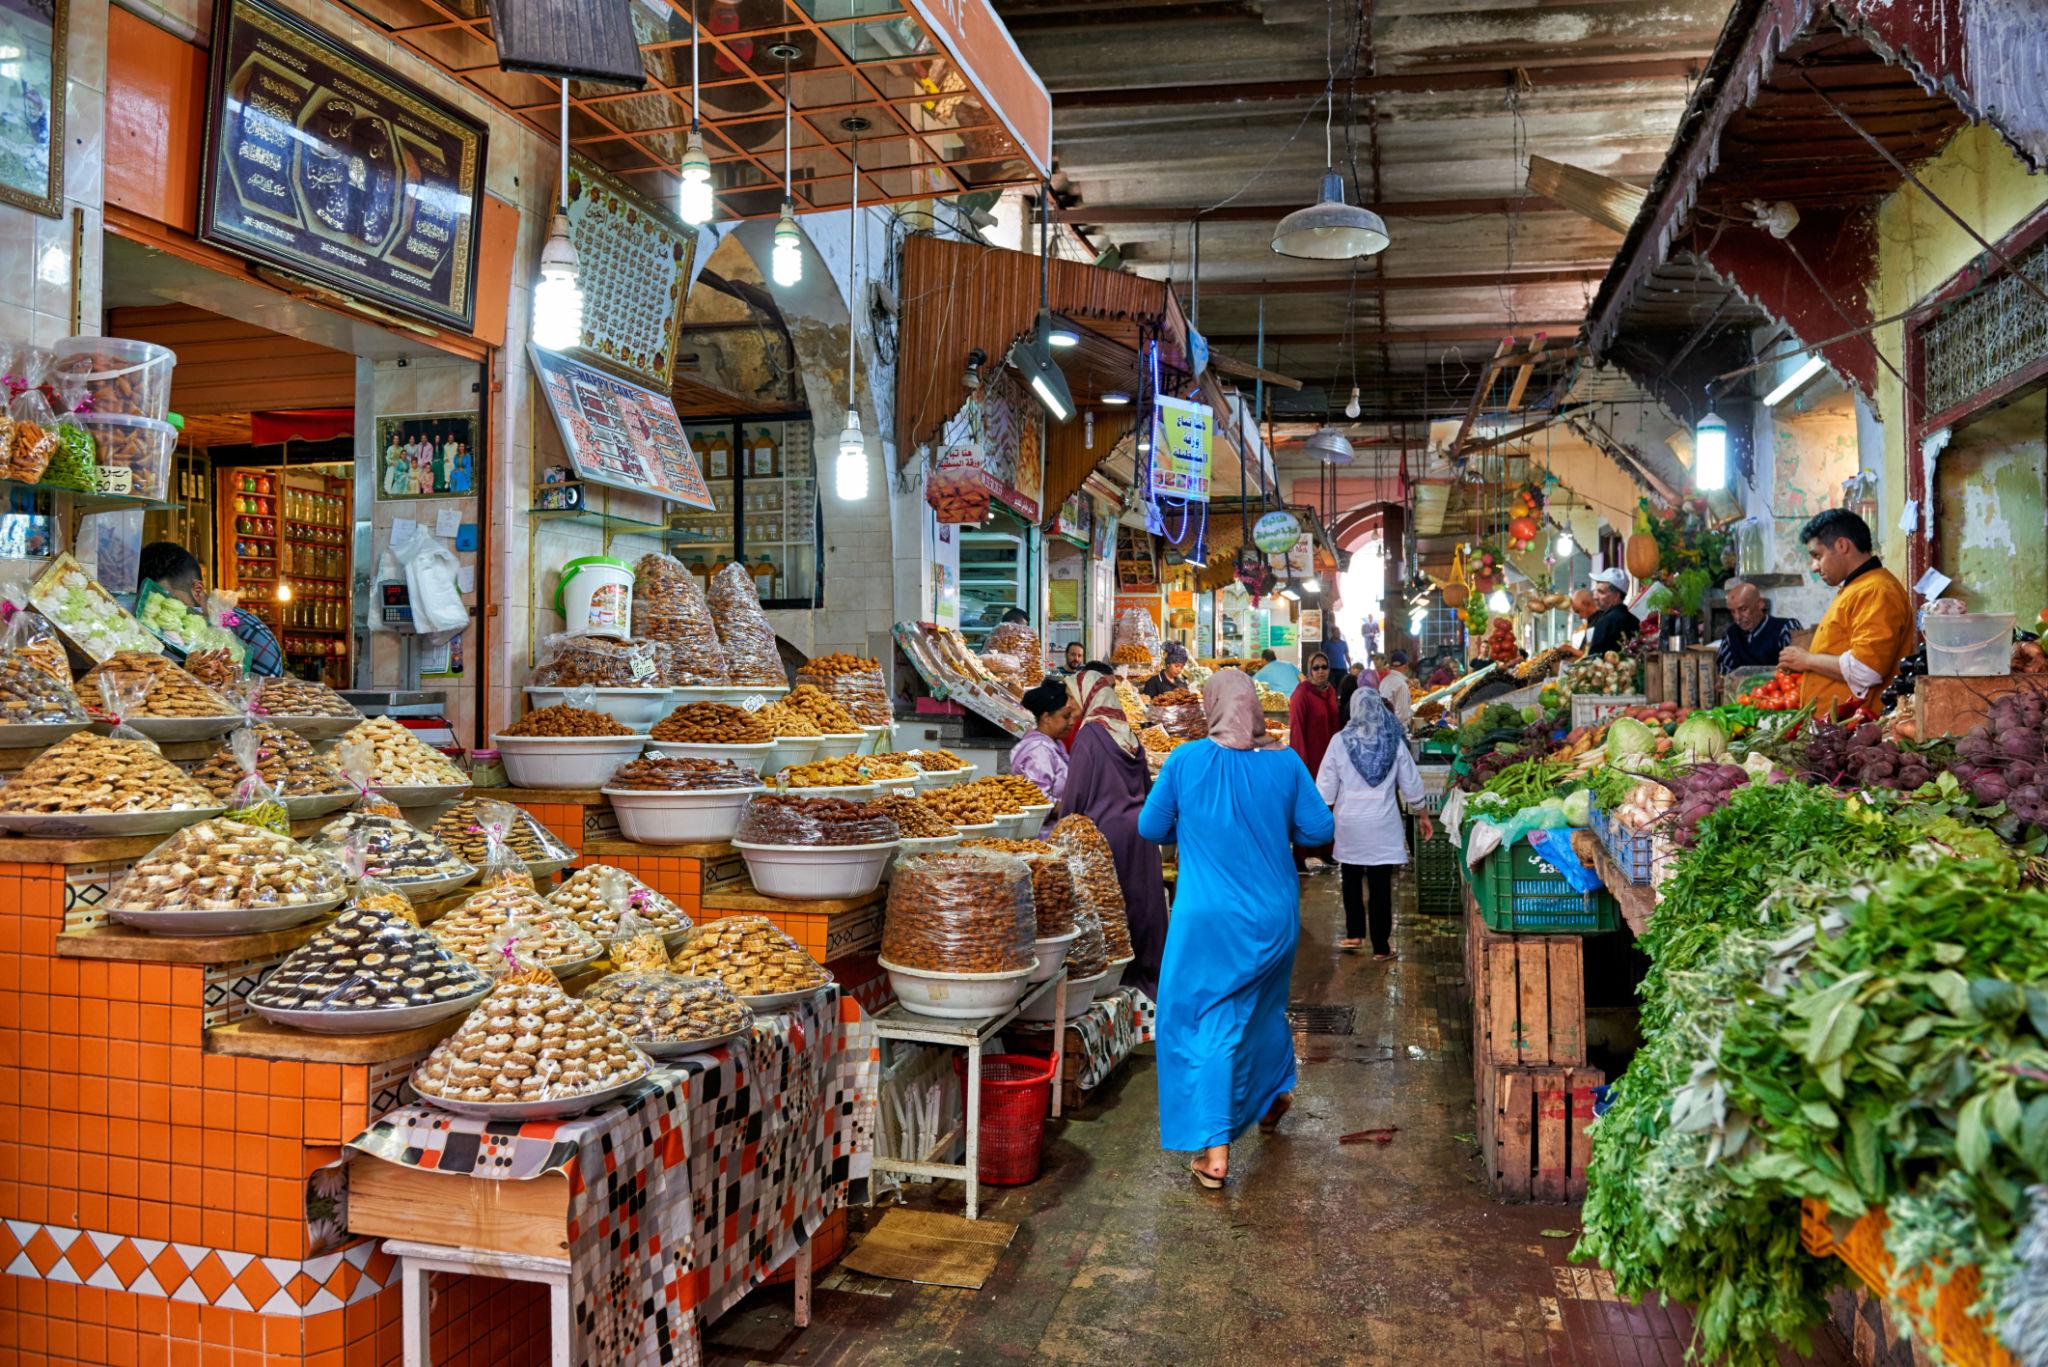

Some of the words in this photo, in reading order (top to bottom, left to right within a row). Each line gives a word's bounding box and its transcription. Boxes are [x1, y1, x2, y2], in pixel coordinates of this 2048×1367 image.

[577, 368, 609, 392] HAPPY
[611, 381, 636, 401] CAKE
[961, 448, 973, 457] هنا
[965, 459, 980, 469] ورقة
[96, 480, 111, 492] 50
